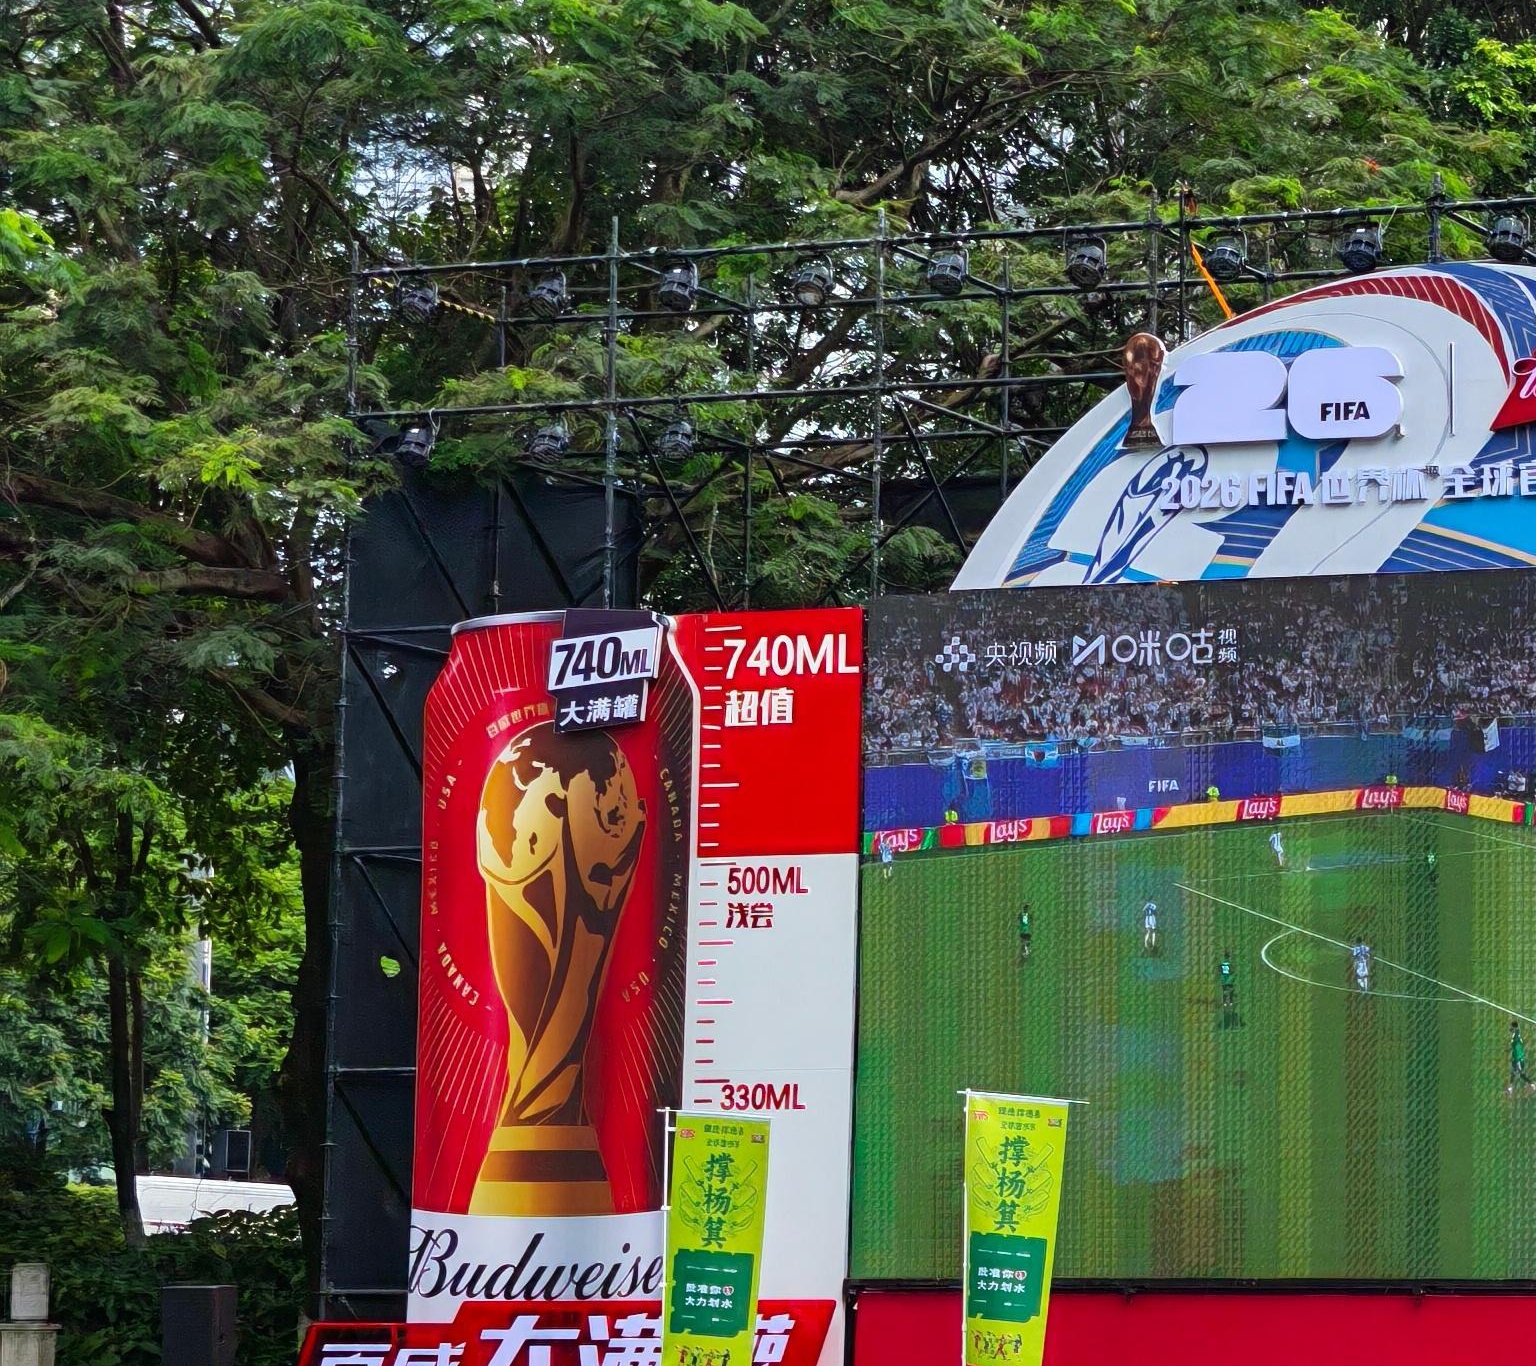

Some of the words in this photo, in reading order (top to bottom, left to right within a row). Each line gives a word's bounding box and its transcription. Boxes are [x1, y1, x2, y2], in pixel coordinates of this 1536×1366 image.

[1319, 401, 1371, 422] FIFA
[554, 636, 651, 691] 740ML
[723, 635, 860, 680] 740ML
[984, 641, 1056, 667] 央视频
[559, 694, 639, 727] 大满罐
[725, 688, 794, 728] 超值
[1149, 779, 1179, 793] FIFA
[727, 866, 809, 896] 500ML
[726, 901, 774, 929] 浅尝
[719, 1083, 806, 1111] 330ML
[994, 1135, 1030, 1232] 撑杨箕
[703, 1152, 734, 1249] 撑杨箕
[409, 1225, 663, 1301] Budweise
